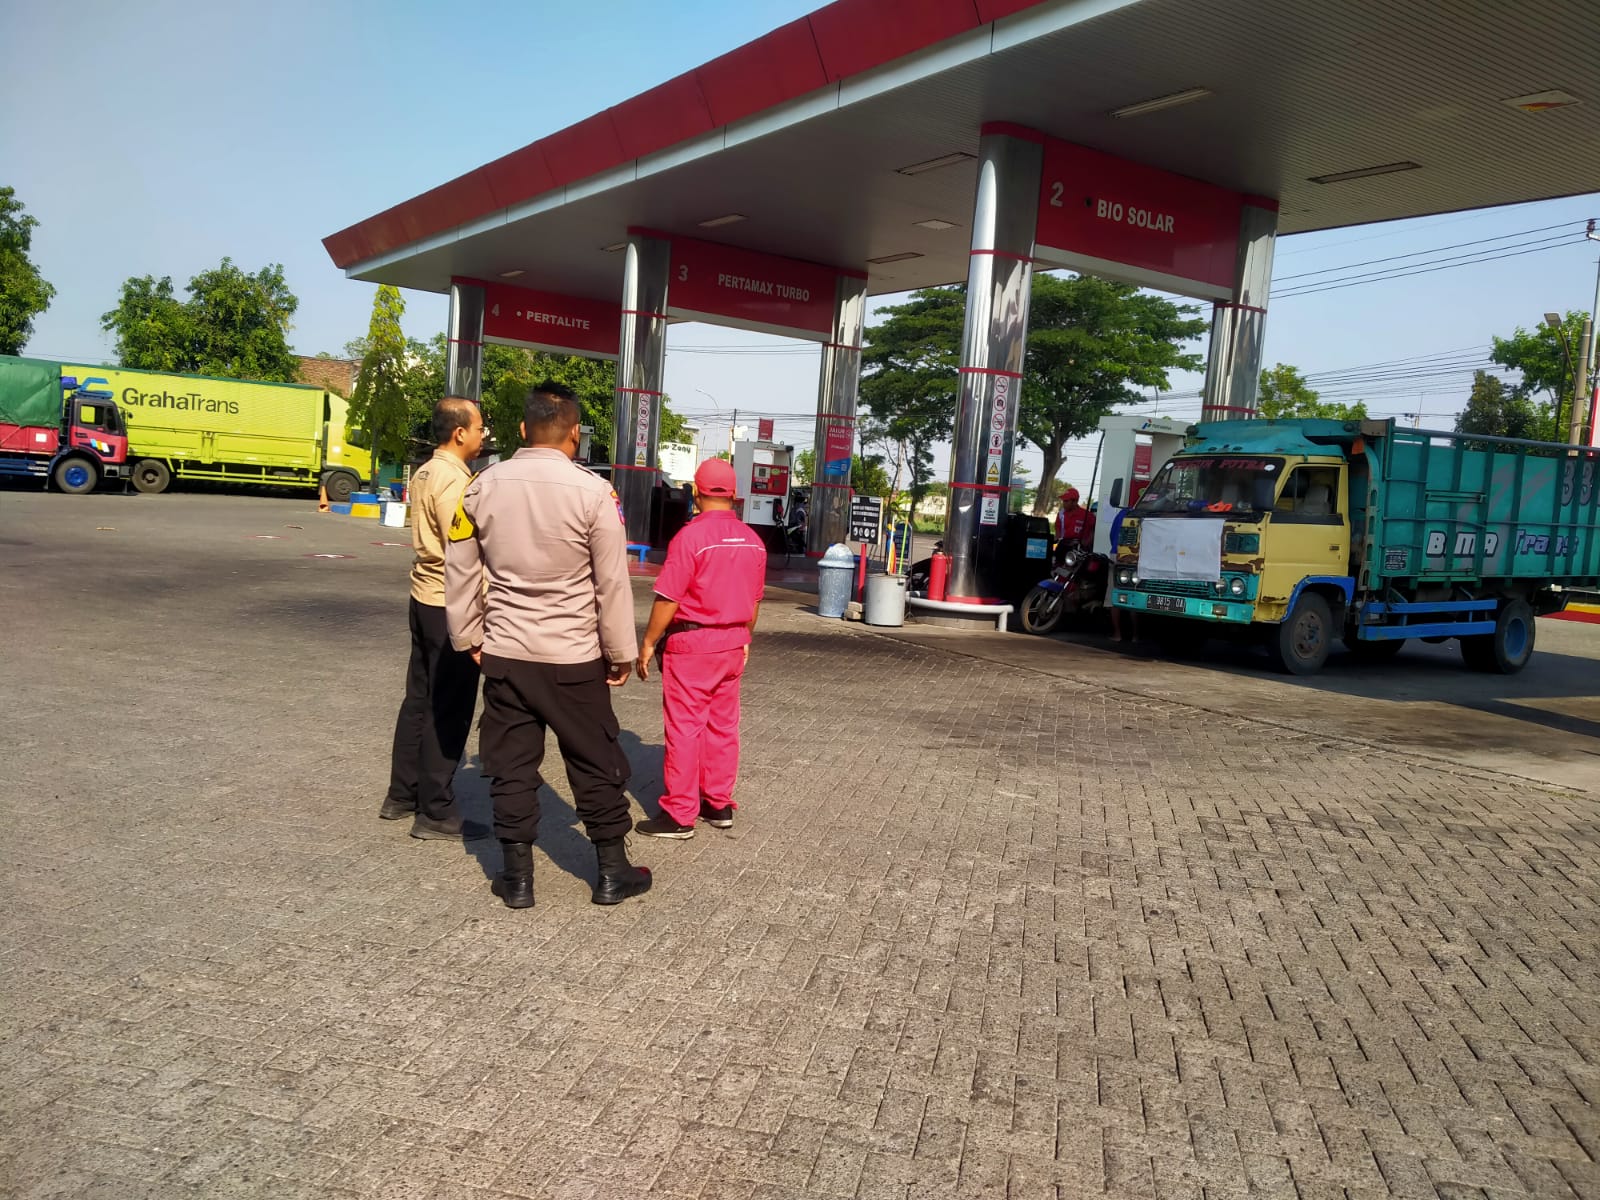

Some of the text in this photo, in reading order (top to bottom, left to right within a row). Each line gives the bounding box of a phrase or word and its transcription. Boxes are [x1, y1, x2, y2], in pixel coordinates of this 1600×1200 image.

[1050, 182, 1175, 234] 2 BIO SOLAR
[678, 265, 810, 302] 3 PERTAMAX TURBO
[491, 304, 590, 330] 4 PERTALITE
[121, 387, 239, 414] GrahaTrans
